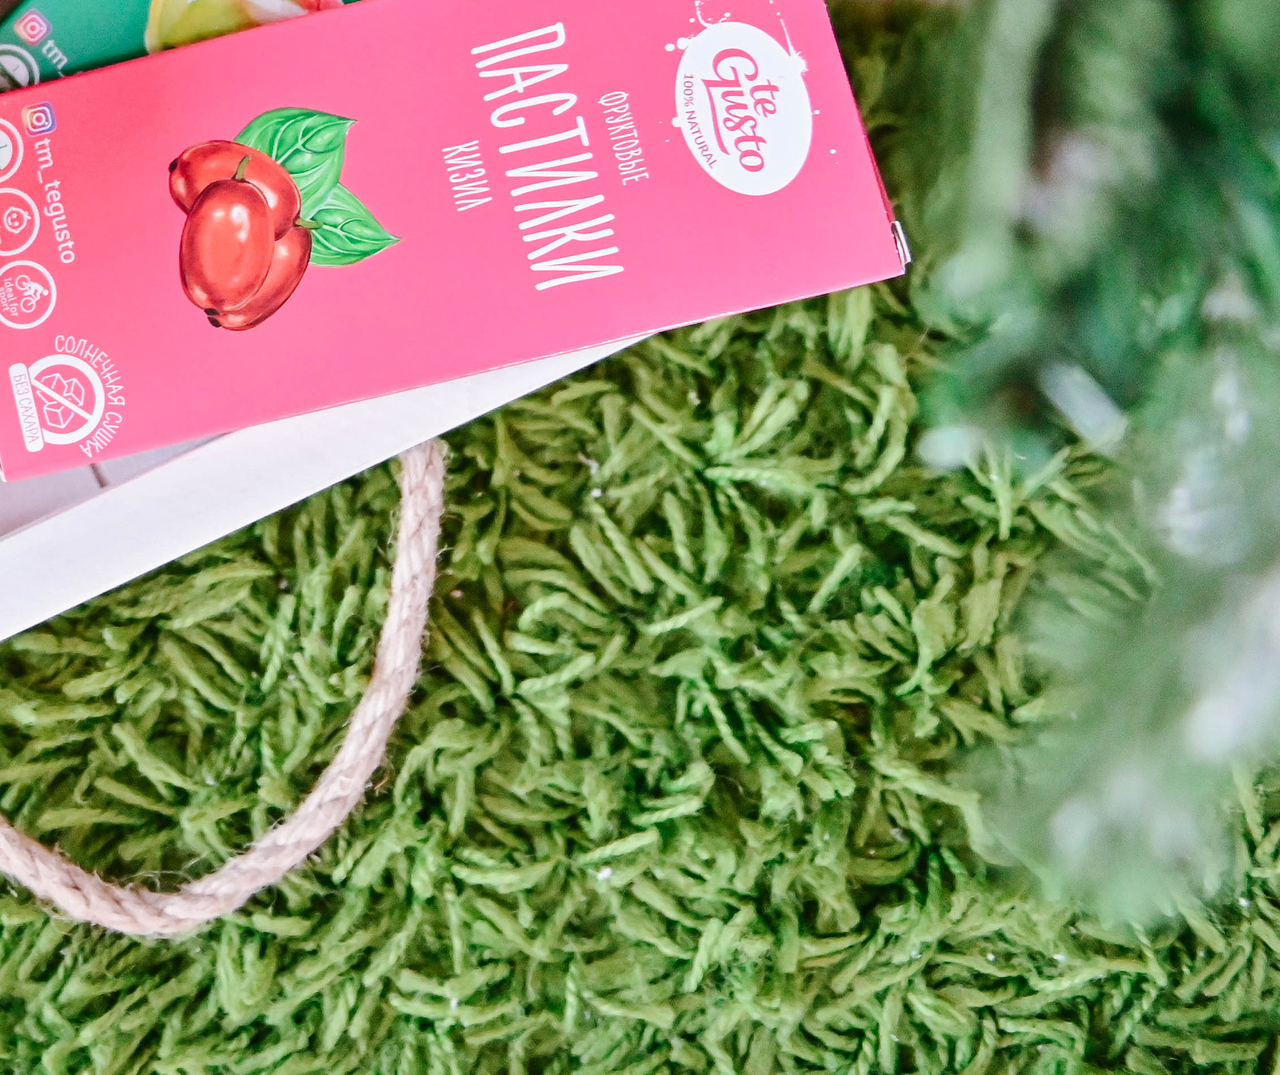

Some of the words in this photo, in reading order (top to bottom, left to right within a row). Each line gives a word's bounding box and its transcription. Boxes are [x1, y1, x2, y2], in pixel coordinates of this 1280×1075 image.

[682, 73, 694, 108] 100%
[700, 48, 767, 173] Gusto
[756, 78, 778, 118] te
[471, 22, 624, 290] ПАСТИЛКИ
[598, 91, 649, 186] ФРУКТОВЫЕ
[686, 110, 718, 170] NATURAL
[34, 138, 76, 264] tm_tegusto
[442, 140, 493, 212] КИЗИЛ
[14, 373, 28, 395] БЕЗ
[55, 335, 126, 406] СОЛНЕЧНАЯ
[19, 397, 40, 444] САХАРА
[79, 412, 123, 458] СУШКА
